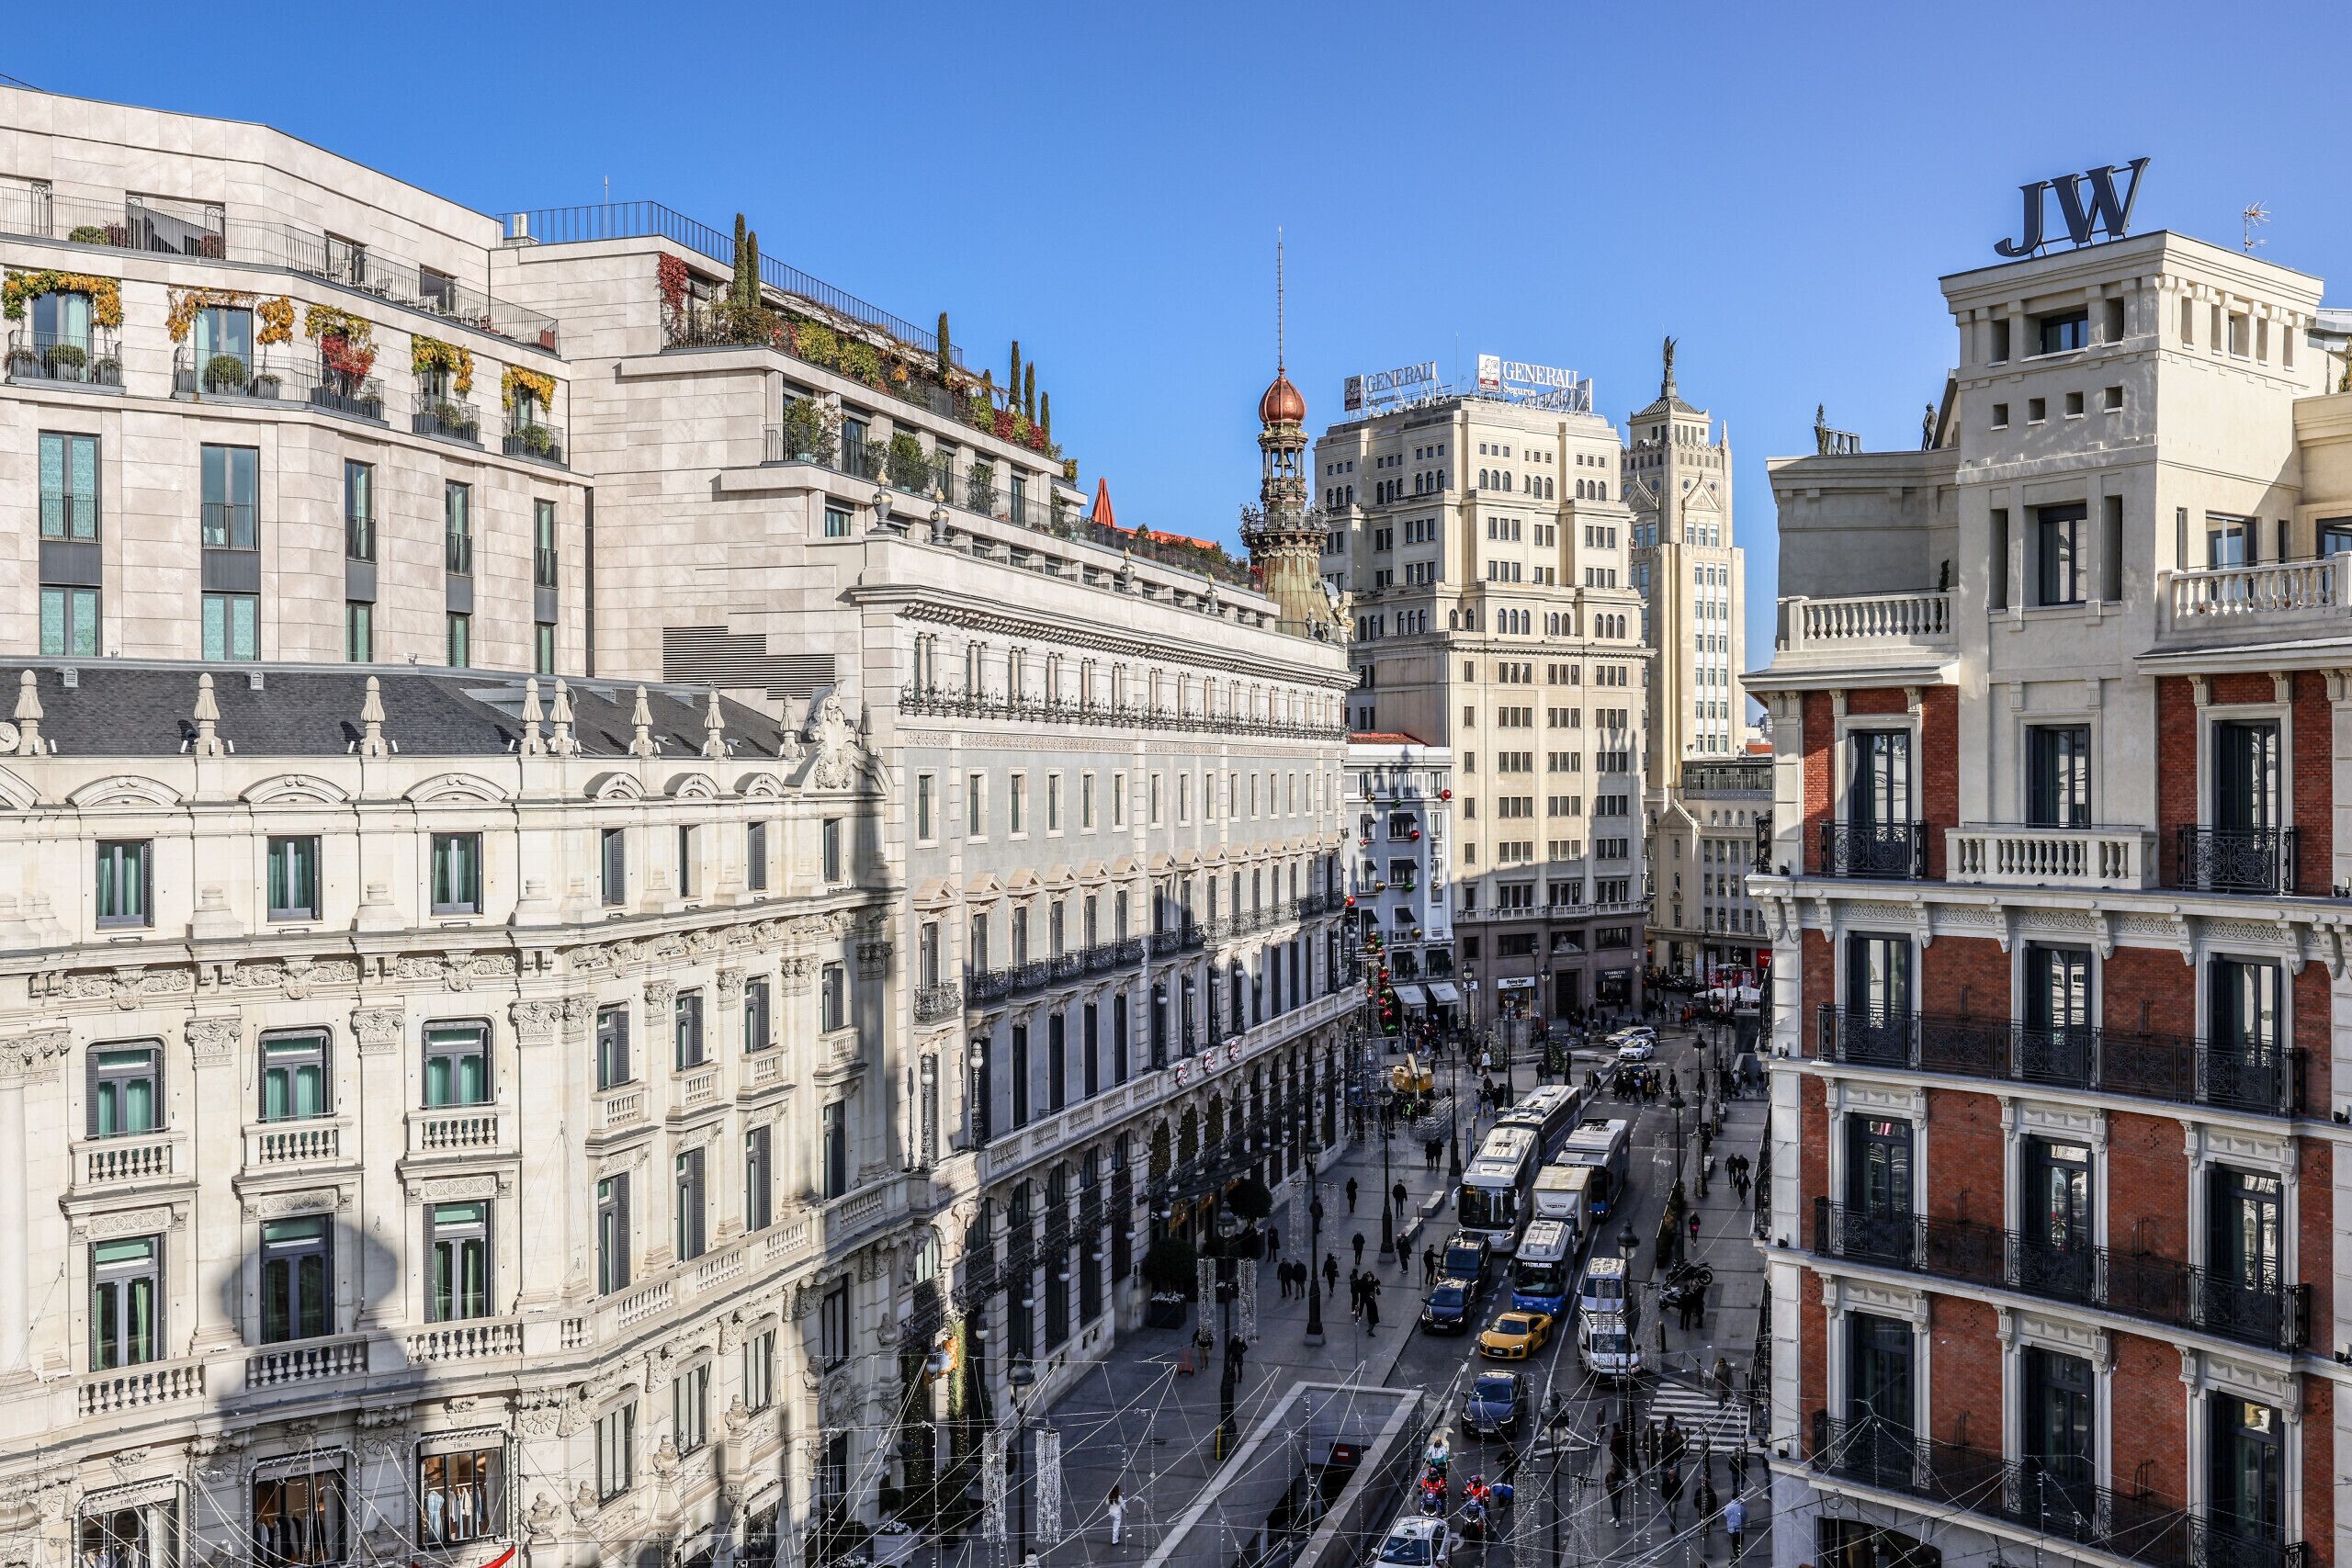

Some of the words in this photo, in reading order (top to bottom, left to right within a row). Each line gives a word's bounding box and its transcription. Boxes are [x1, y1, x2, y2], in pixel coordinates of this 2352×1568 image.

[1994, 157, 2151, 257] JW
[1366, 361, 1436, 393] GENERALI
[1502, 361, 1578, 389] GENERALI
[1503, 382, 1537, 398] Seguros
[453, 1441, 471, 1450] DIOR
[290, 1465, 309, 1473] DIOR
[120, 1496, 140, 1506] DIOR
